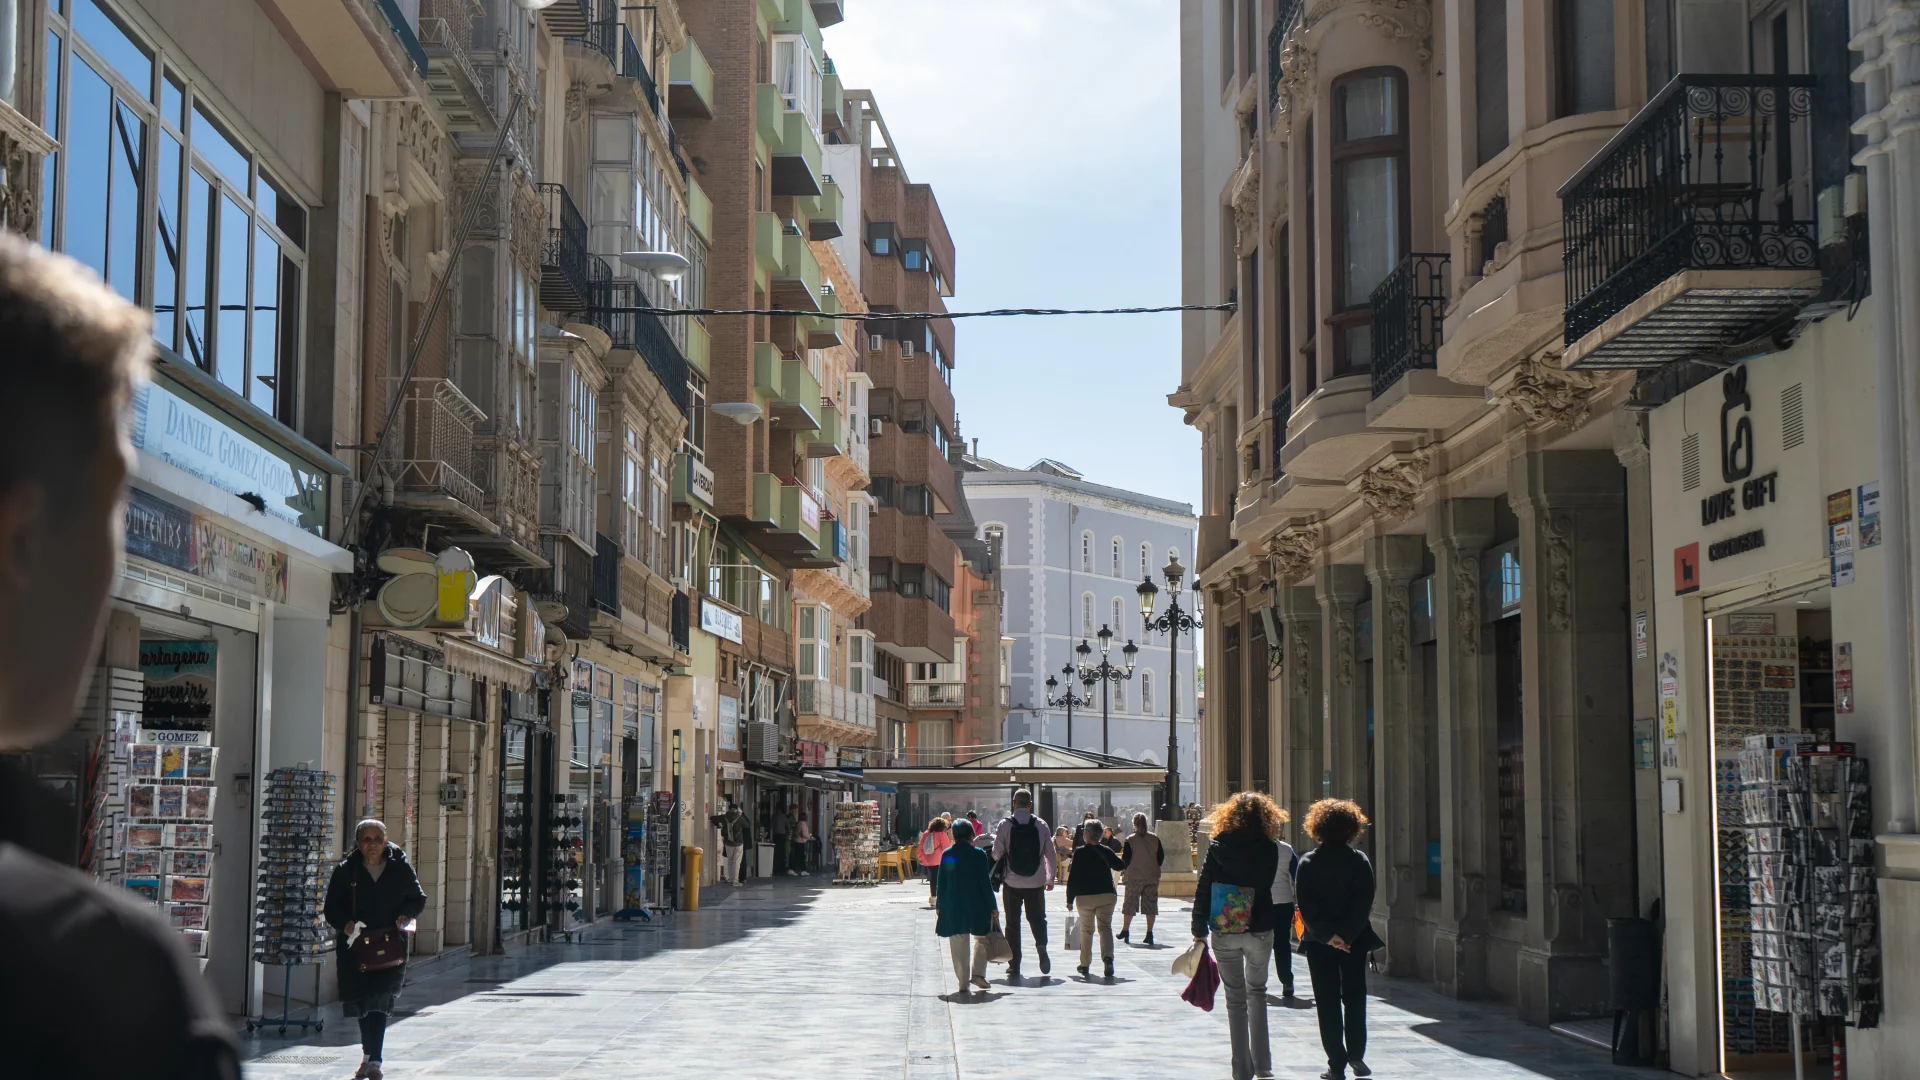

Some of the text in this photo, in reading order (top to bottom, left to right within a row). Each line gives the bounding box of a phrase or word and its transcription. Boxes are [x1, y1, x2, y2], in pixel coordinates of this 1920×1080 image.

[165, 397, 214, 458] DANIEL
[219, 431, 259, 481] GOMEZ
[1701, 471, 1778, 527] LOVE GIFT
[125, 501, 181, 549] OUVENIRS
[139, 646, 209, 673] artagena
[143, 681, 208, 700] ouvenirs
[157, 732, 199, 743] GOMEZ
